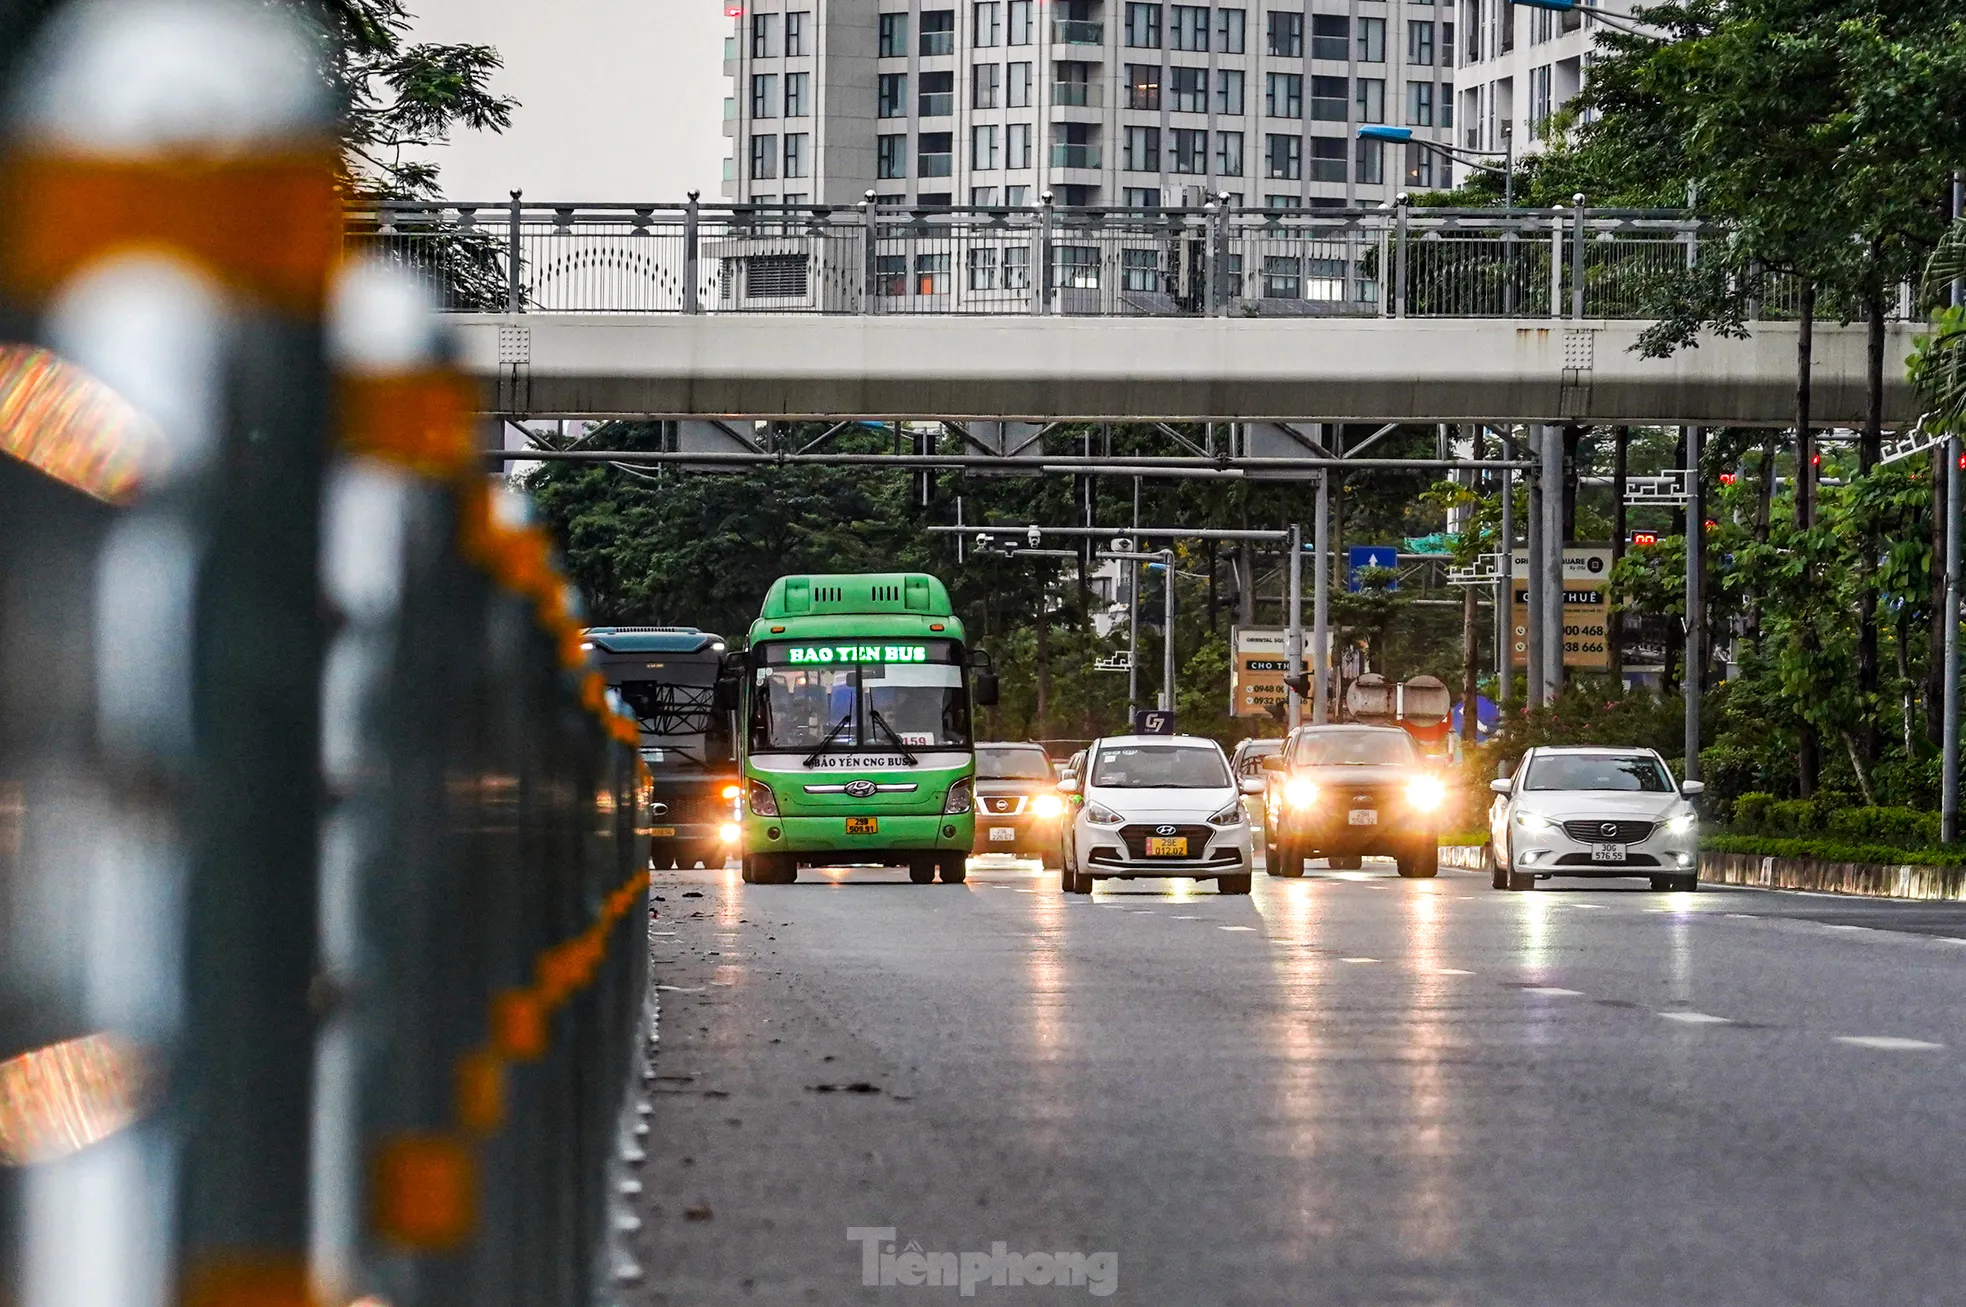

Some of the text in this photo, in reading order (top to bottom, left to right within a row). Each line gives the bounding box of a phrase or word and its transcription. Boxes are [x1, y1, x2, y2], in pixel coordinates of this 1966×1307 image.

[1563, 626, 1603, 636] 00 468
[1563, 642, 1603, 652] 38 666
[884, 646, 925, 661] BUS
[1254, 685, 1274, 693] 0948
[1254, 697, 1273, 705] 0932
[863, 758, 885, 767] CNG
[888, 758, 907, 766] BUS
[1595, 851, 1623, 860] 576.55
